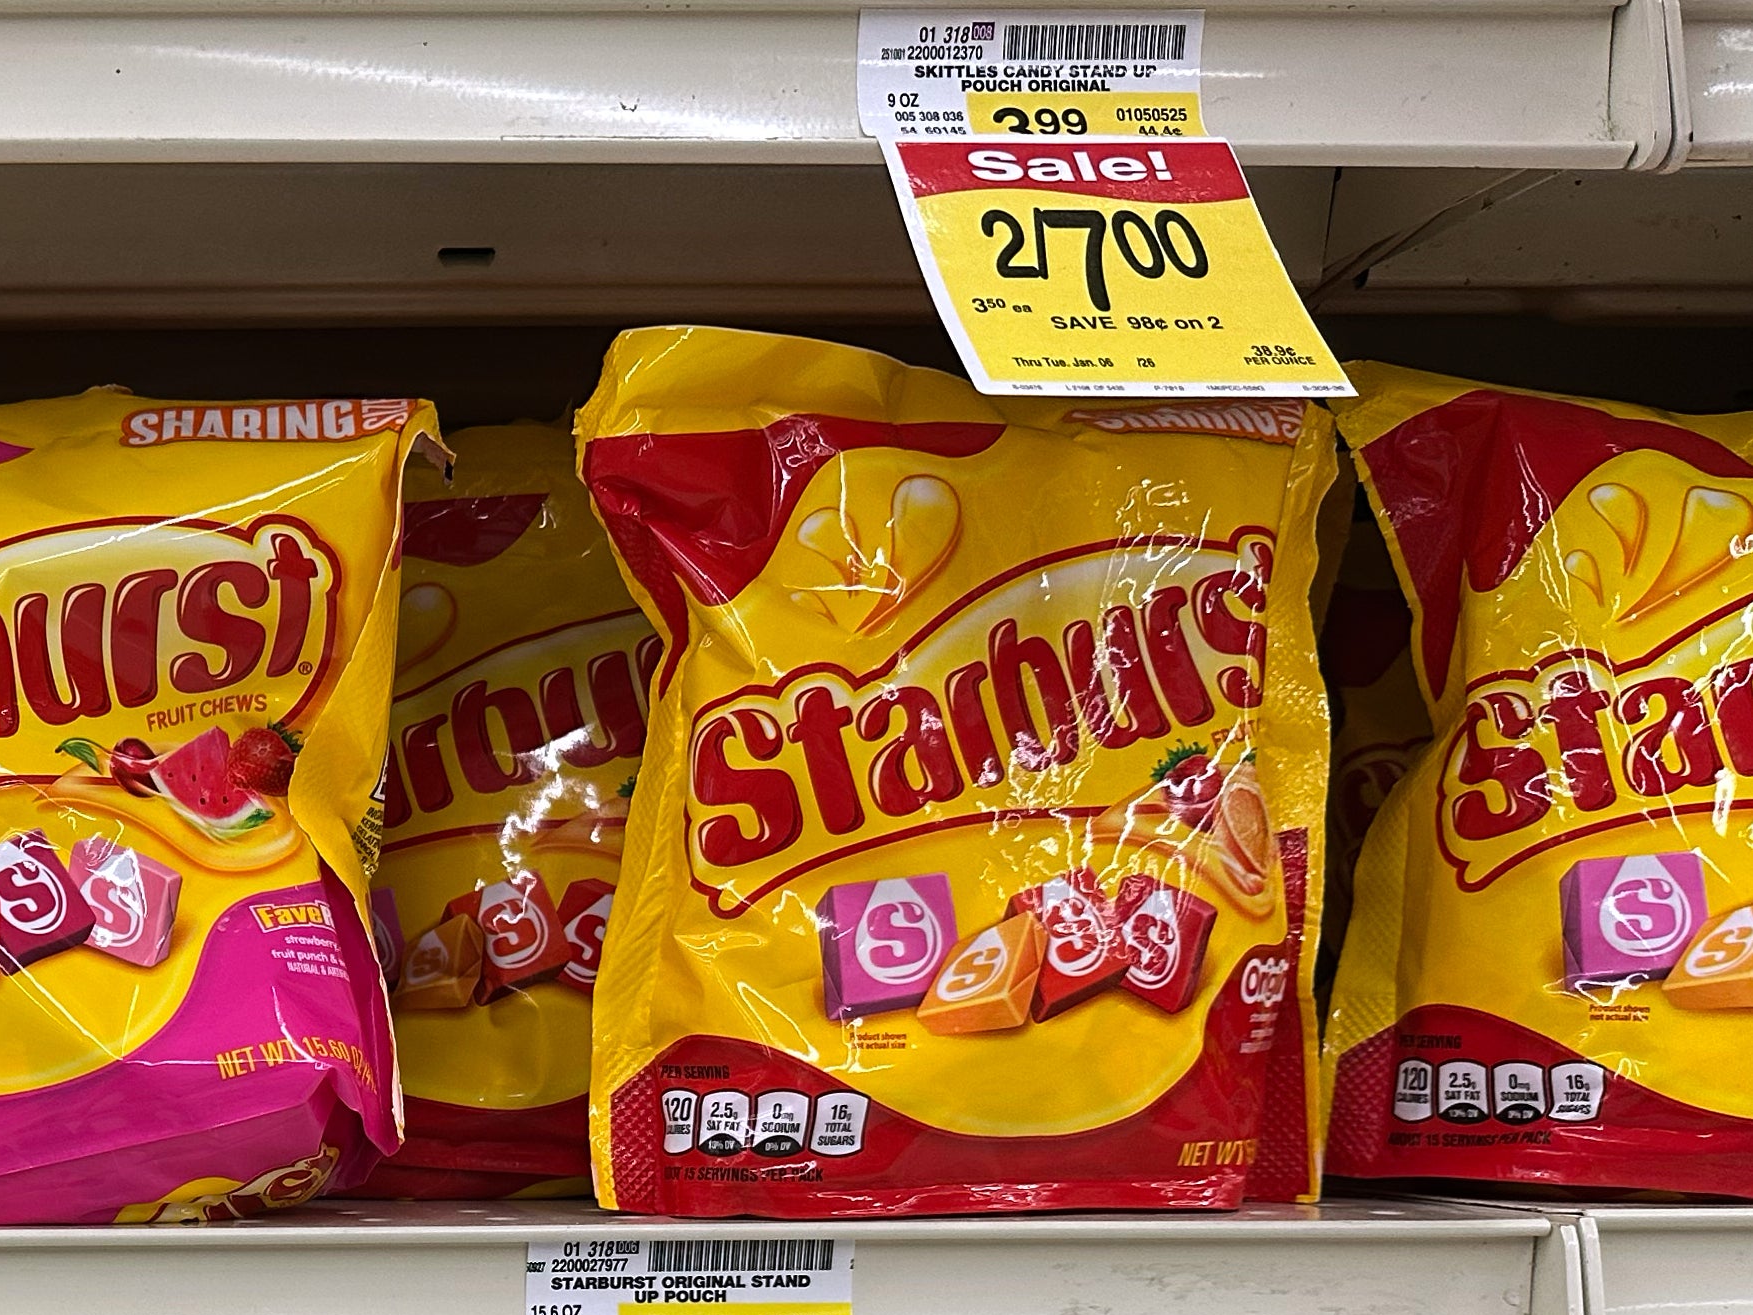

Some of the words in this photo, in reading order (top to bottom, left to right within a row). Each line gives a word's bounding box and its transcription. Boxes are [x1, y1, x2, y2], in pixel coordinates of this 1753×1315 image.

[907, 45, 983, 61] 2200012370
[914, 64, 998, 79] SKITTLES
[1003, 64, 1063, 79] CANDY
[1068, 64, 1127, 79] STAND
[1133, 64, 1157, 79] UP
[961, 79, 1023, 92] POUCH
[1028, 79, 1110, 92] ORIGINAL
[887, 93, 896, 108] 9
[900, 93, 920, 108] OZ
[1116, 108, 1187, 123] 01050525
[966, 149, 1174, 183] Sale!
[1012, 303, 1032, 313] ea
[1050, 316, 1117, 330] SAVE
[1127, 316, 1168, 331] 98¢
[1174, 317, 1202, 330] on
[1207, 316, 1224, 330] 2
[1250, 344, 1296, 358] 38.9¢
[1013, 357, 1040, 368] Thru
[1041, 357, 1070, 368] Tue.
[1243, 356, 1266, 366] PER
[1269, 356, 1317, 366] OUNCE
[128, 402, 355, 445] SHARING
[147, 702, 200, 733] FRUIT
[202, 693, 267, 722] CHEWS
[552, 1259, 628, 1272] 2200027977
[551, 1277, 657, 1290] STARBURST
[662, 1276, 746, 1289] ORIGINAL
[751, 1275, 811, 1288] STAND
[635, 1291, 658, 1303] UP
[664, 1290, 727, 1302] POUCH
